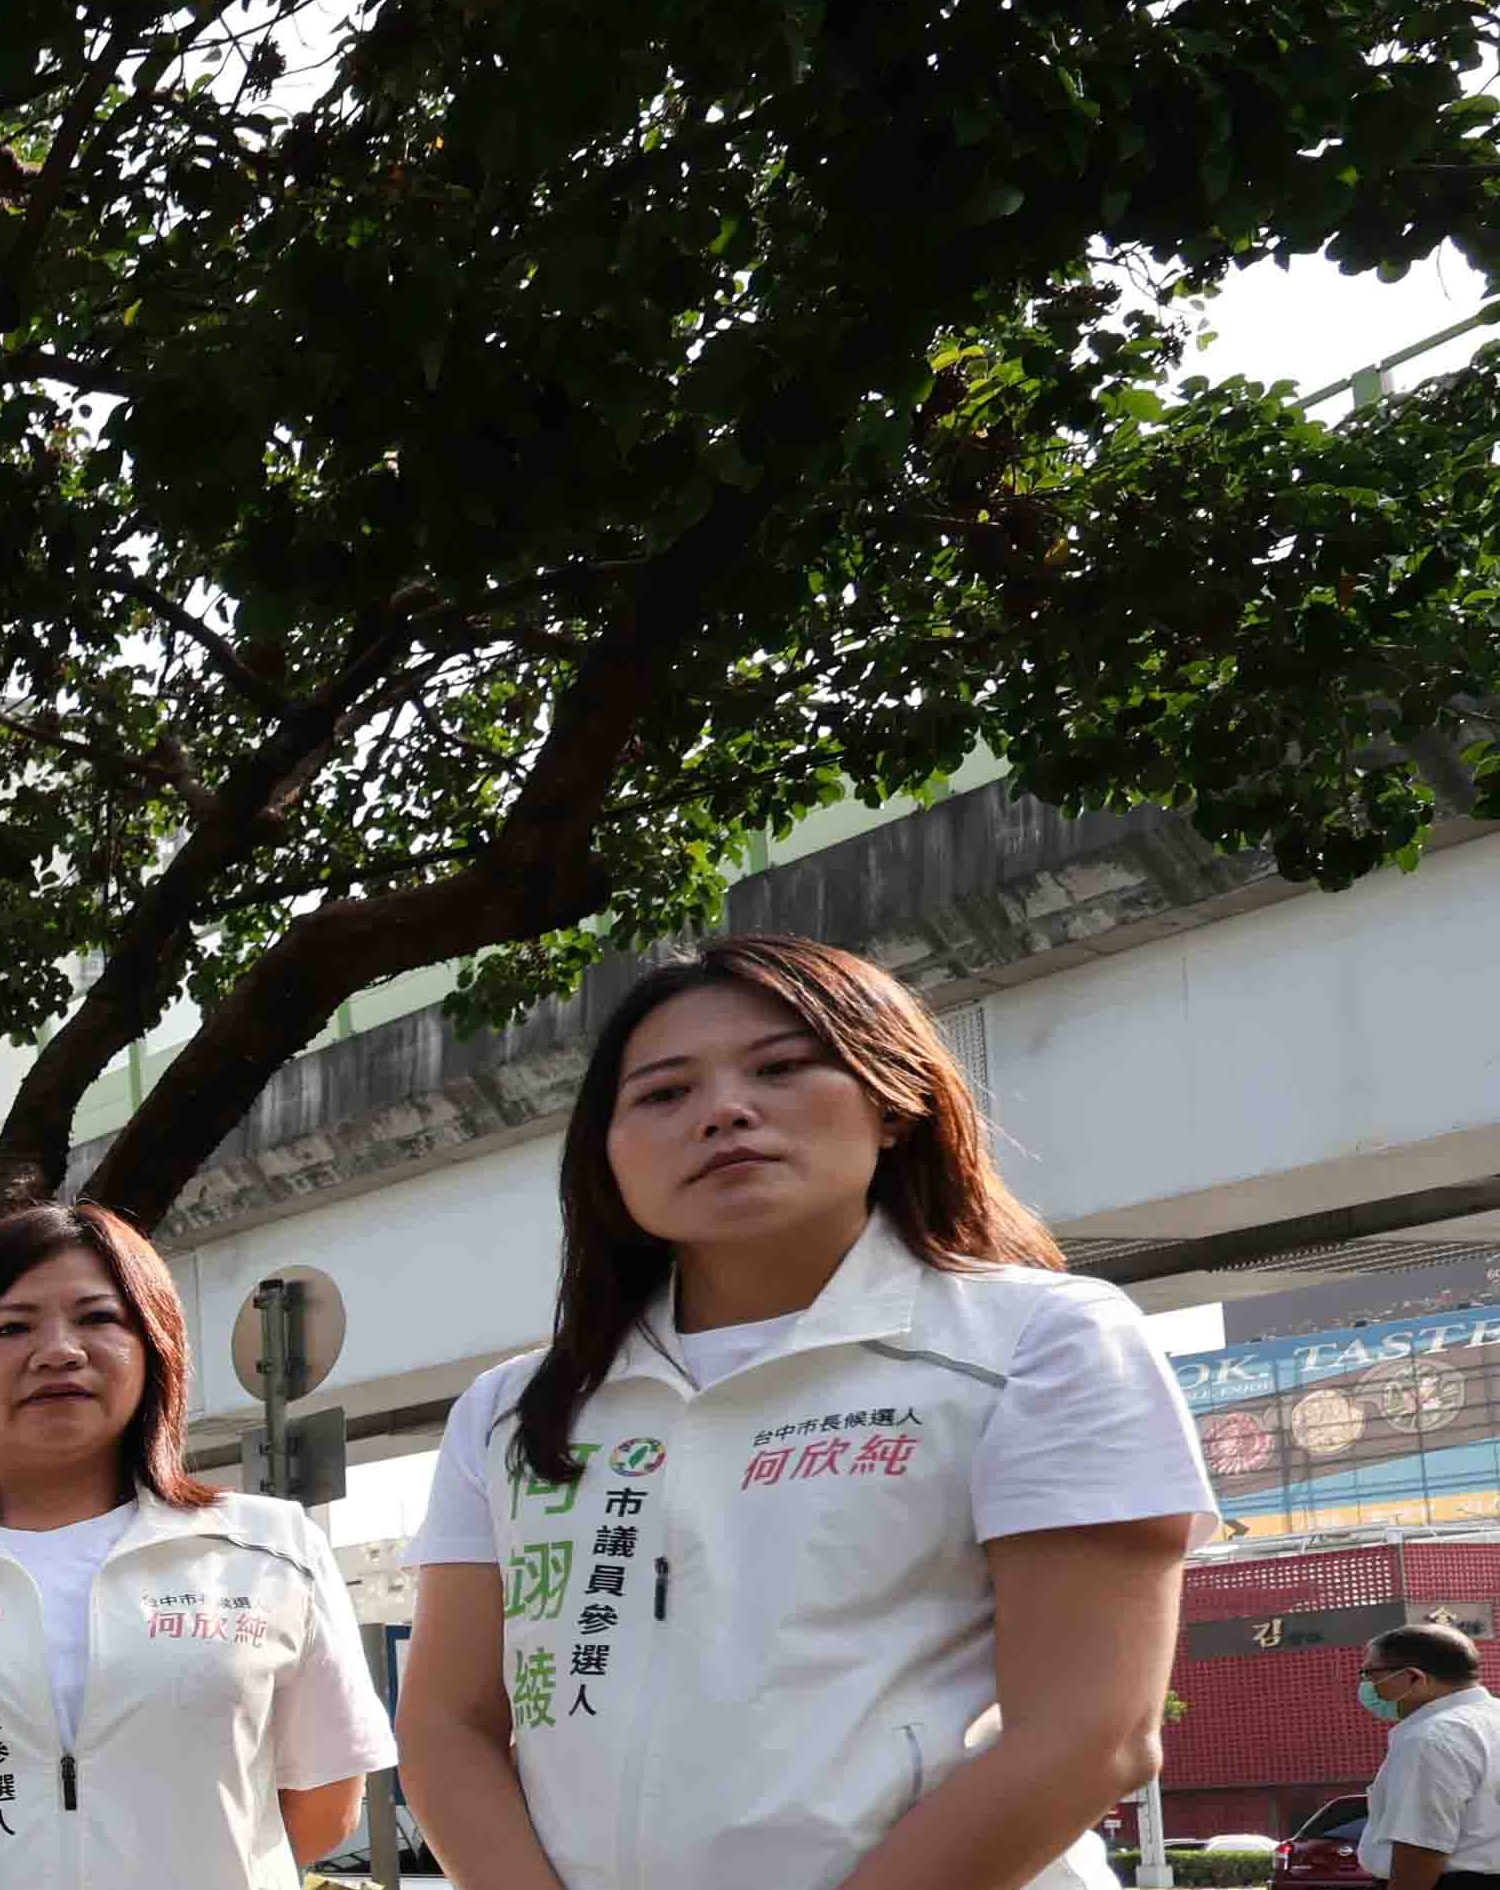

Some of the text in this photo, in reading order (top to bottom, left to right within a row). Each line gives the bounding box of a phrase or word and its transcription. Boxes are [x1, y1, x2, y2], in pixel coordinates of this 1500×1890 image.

[753, 1407, 922, 1447] 台中市長候選人
[741, 1434, 924, 1490] 何欣純
[568, 1488, 648, 1716] 市議員參選人
[148, 1612, 267, 1647] 何欣純
